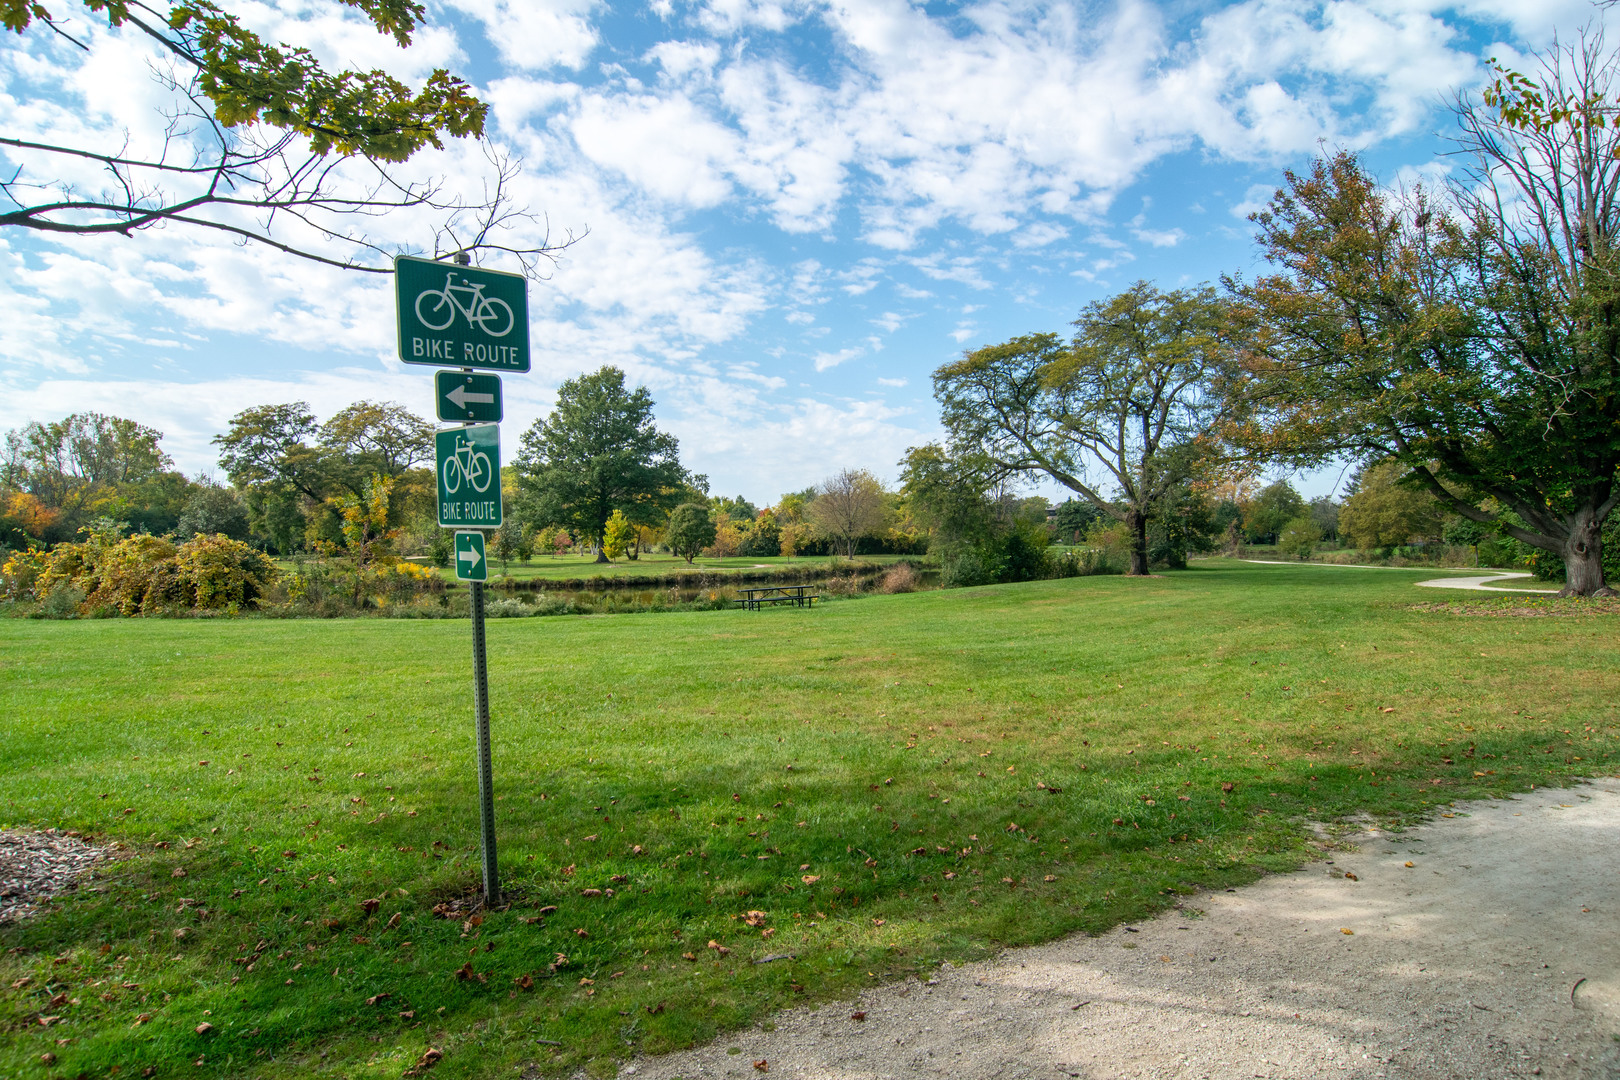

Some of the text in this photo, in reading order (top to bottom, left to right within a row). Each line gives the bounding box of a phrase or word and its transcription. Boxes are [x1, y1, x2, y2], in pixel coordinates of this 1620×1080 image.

[413, 337, 519, 365] BIKE ROUTE
[443, 501, 496, 520] BIKE ROUTE
